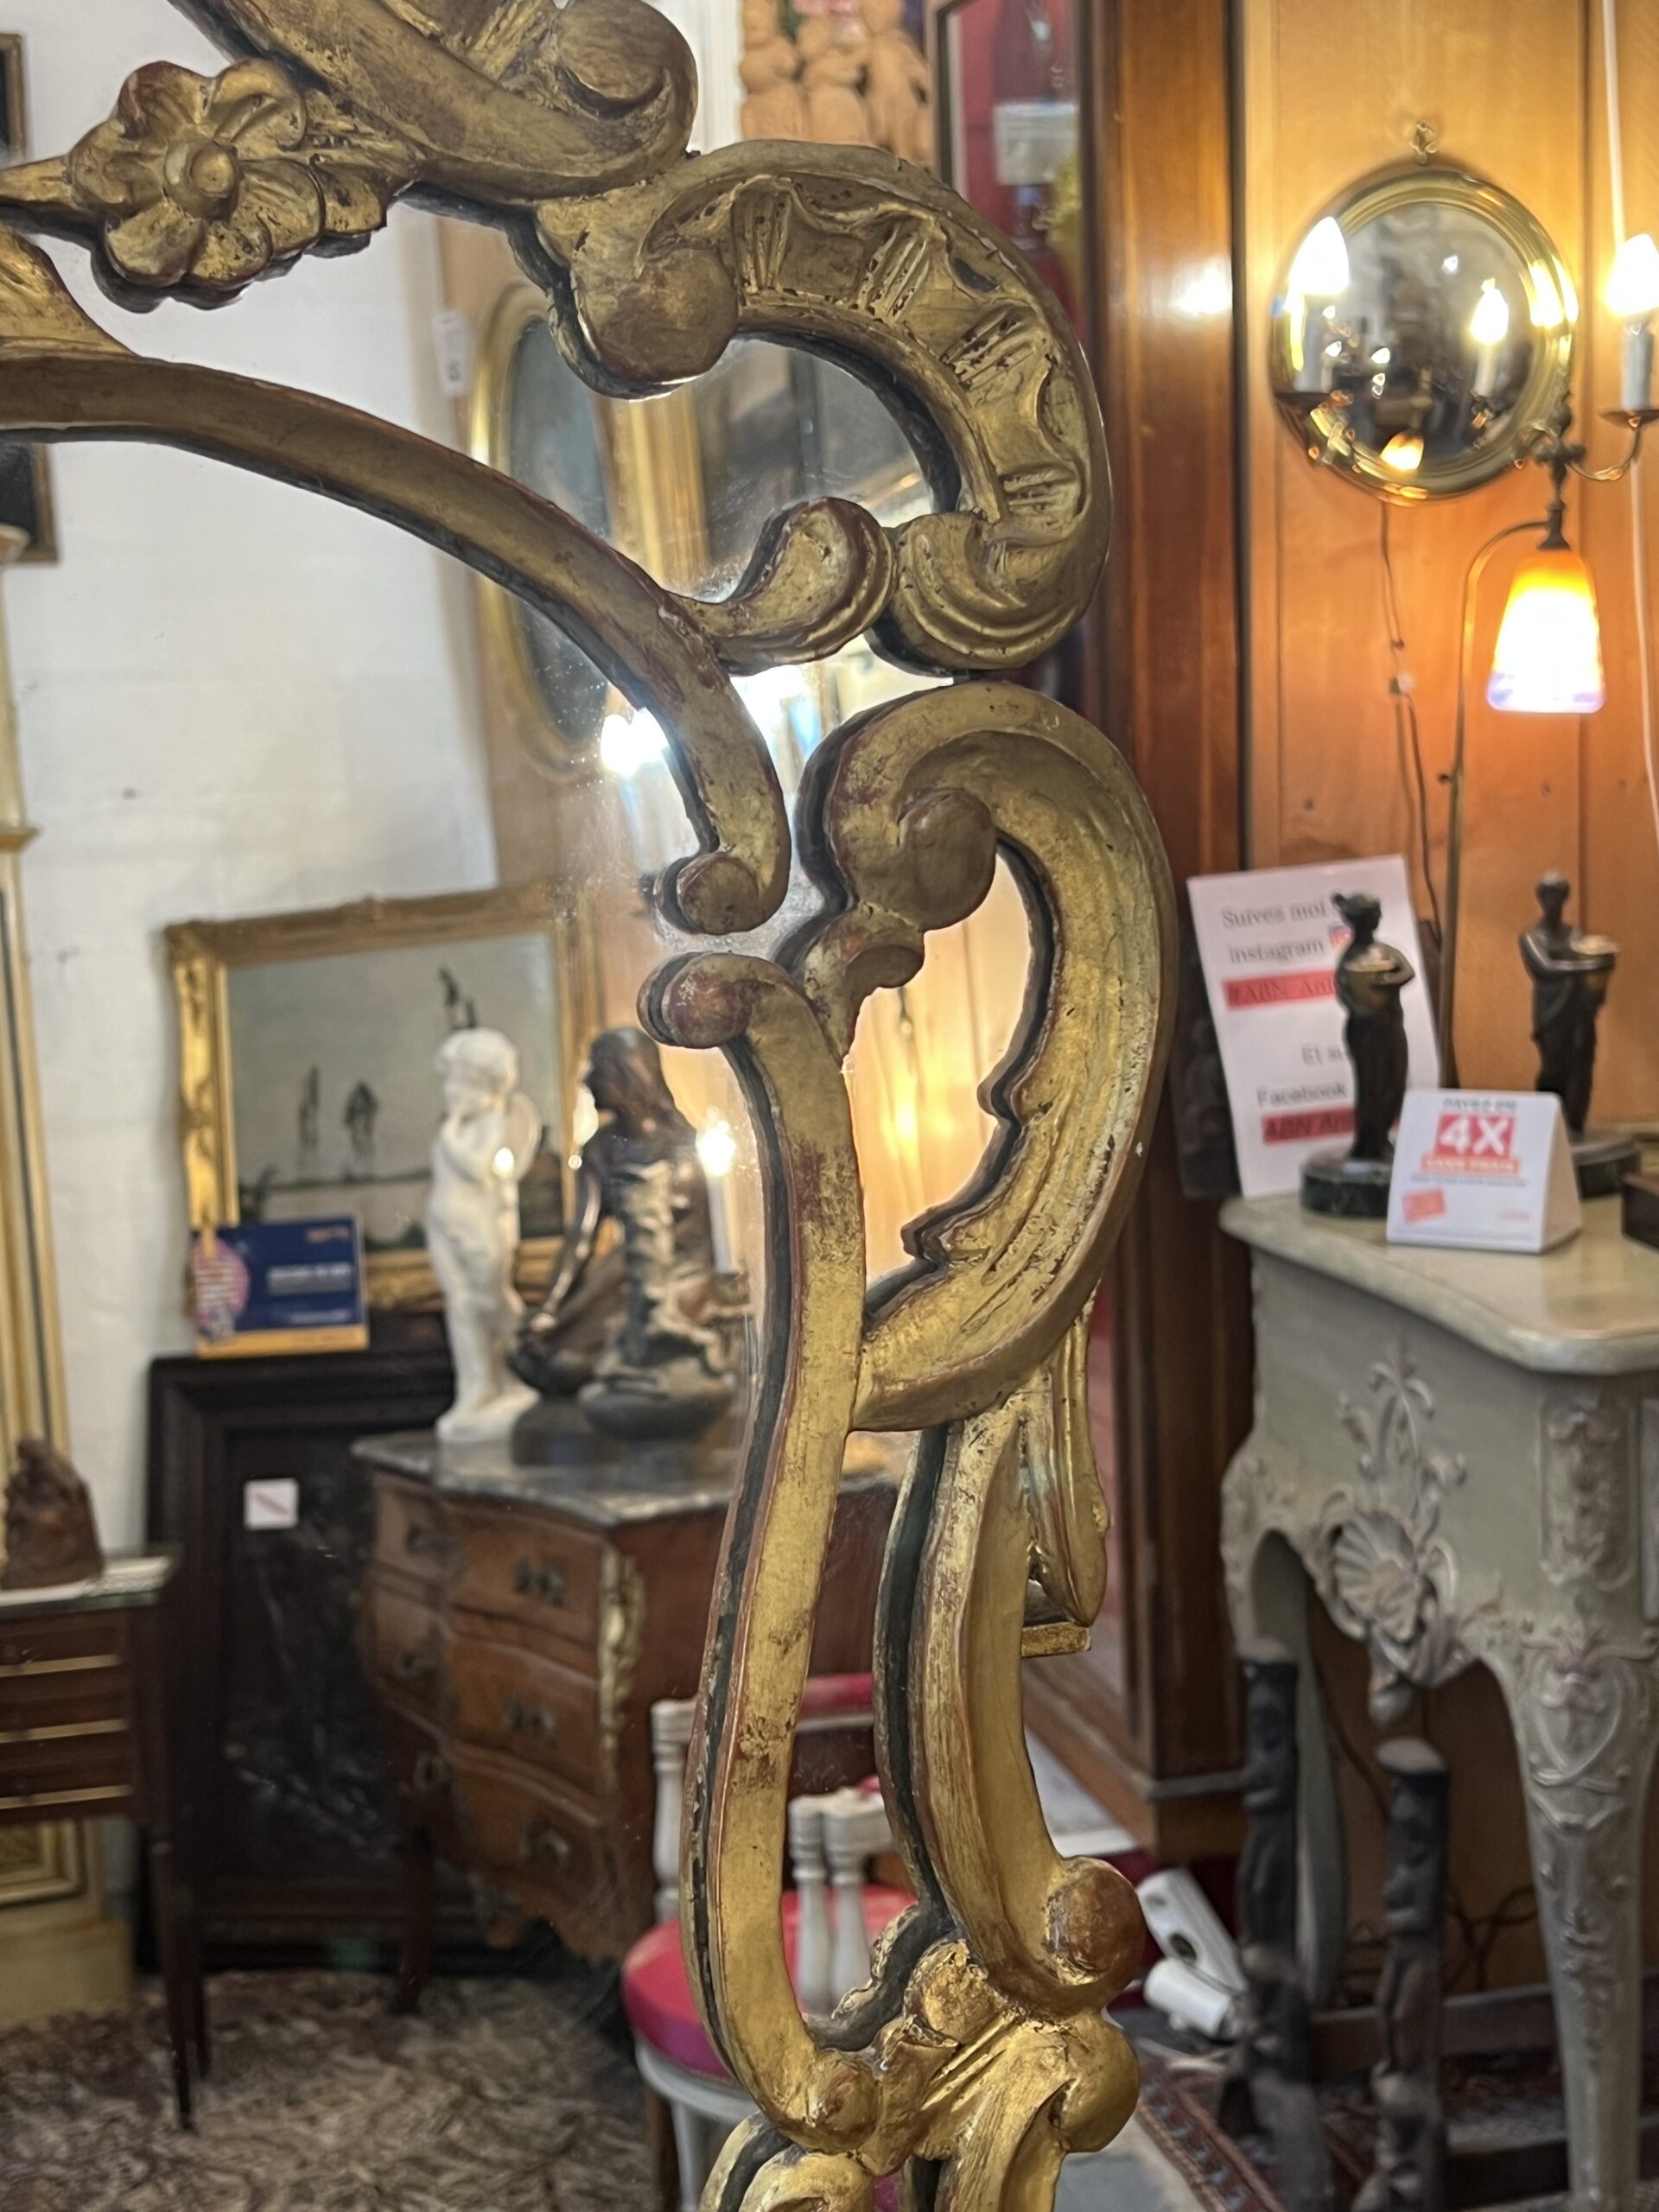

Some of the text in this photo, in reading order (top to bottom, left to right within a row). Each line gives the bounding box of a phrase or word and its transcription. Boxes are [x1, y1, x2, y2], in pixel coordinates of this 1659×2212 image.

[1229, 939, 1325, 965] instagram
[1257, 1083, 1348, 1107] Facebook
[1439, 1117, 1510, 1156] 4X
